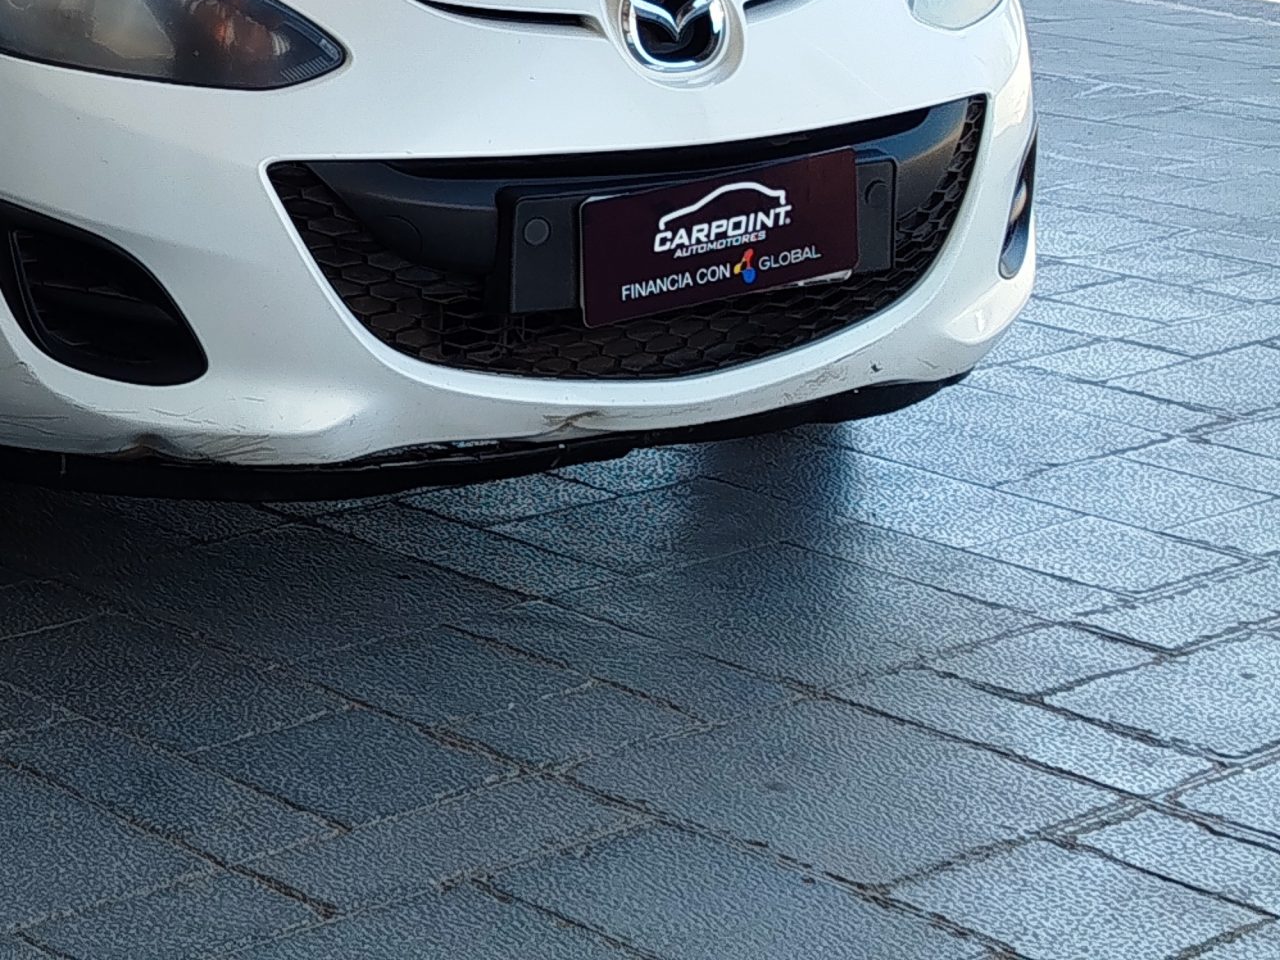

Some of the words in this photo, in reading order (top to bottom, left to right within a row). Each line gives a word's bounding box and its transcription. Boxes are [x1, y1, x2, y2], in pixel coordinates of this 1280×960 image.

[654, 205, 792, 252] CARPOINT
[673, 229, 767, 259] AUTOMOTORES
[620, 271, 694, 302] FINANCIA
[695, 263, 732, 285] CON
[758, 245, 822, 271] GLOBAL
